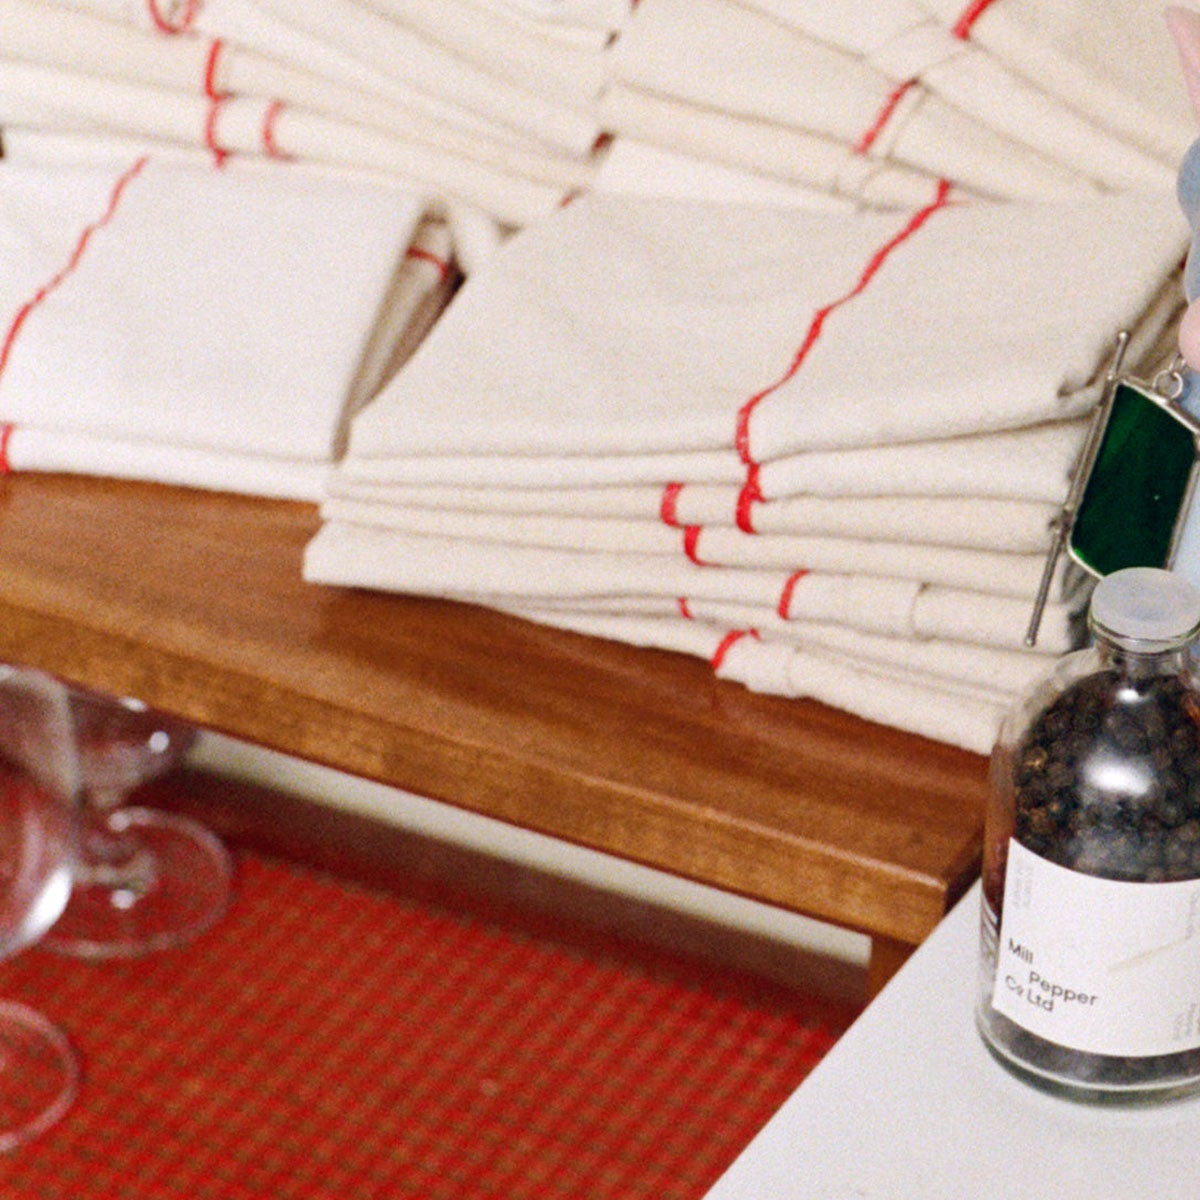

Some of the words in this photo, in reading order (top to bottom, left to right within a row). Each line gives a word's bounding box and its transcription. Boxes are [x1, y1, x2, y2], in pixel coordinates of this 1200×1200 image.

[1008, 937, 1034, 965] Mill
[1027, 988, 1054, 1012] Ltd
[1029, 970, 1098, 1006] Pepper
